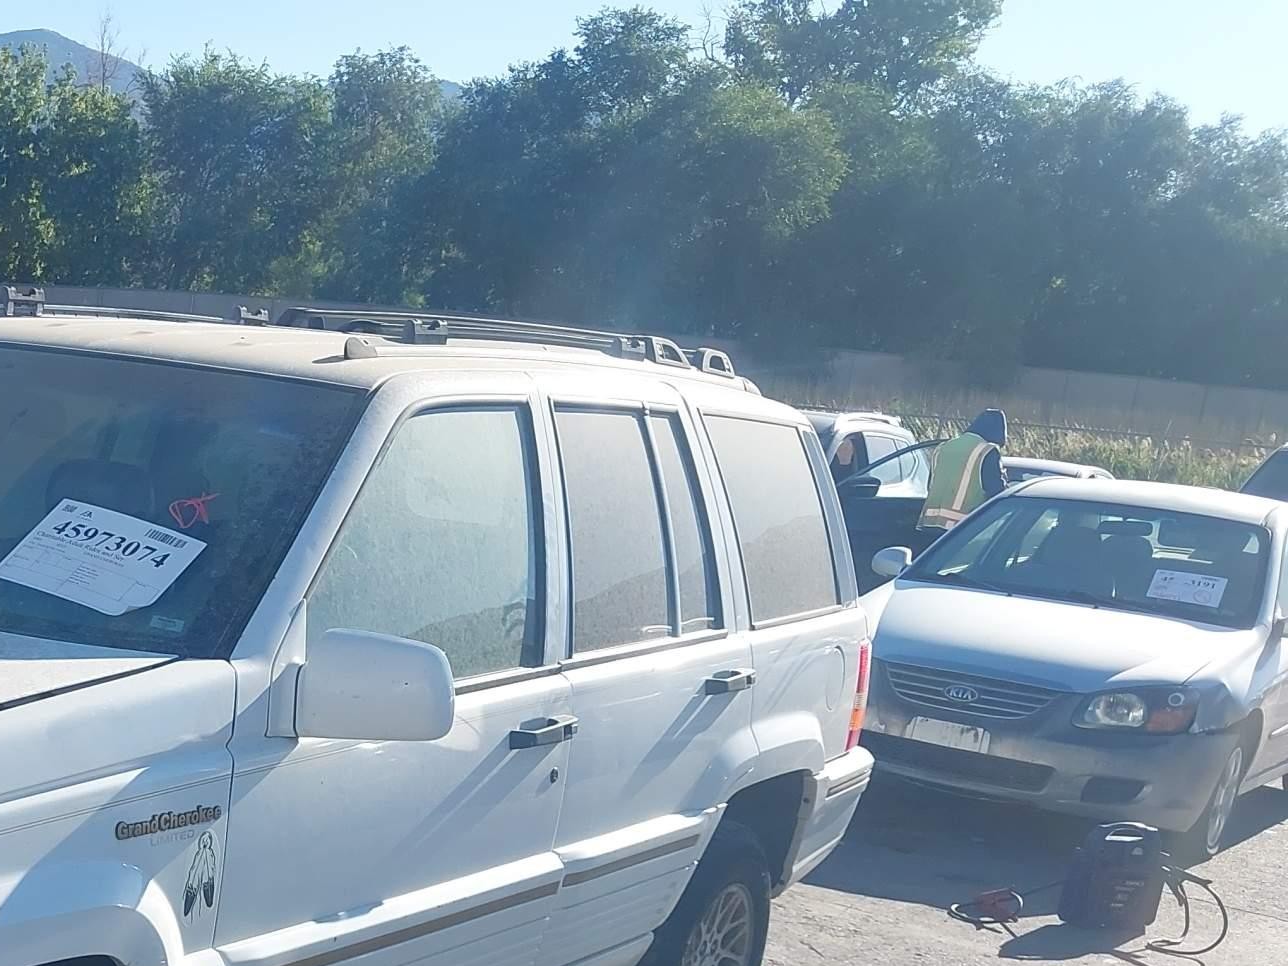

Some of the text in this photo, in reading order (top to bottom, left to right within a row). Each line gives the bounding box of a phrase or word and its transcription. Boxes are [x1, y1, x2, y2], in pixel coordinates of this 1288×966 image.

[52, 520, 172, 569] 45973074
[115, 805, 222, 840] Grand Cherokee
